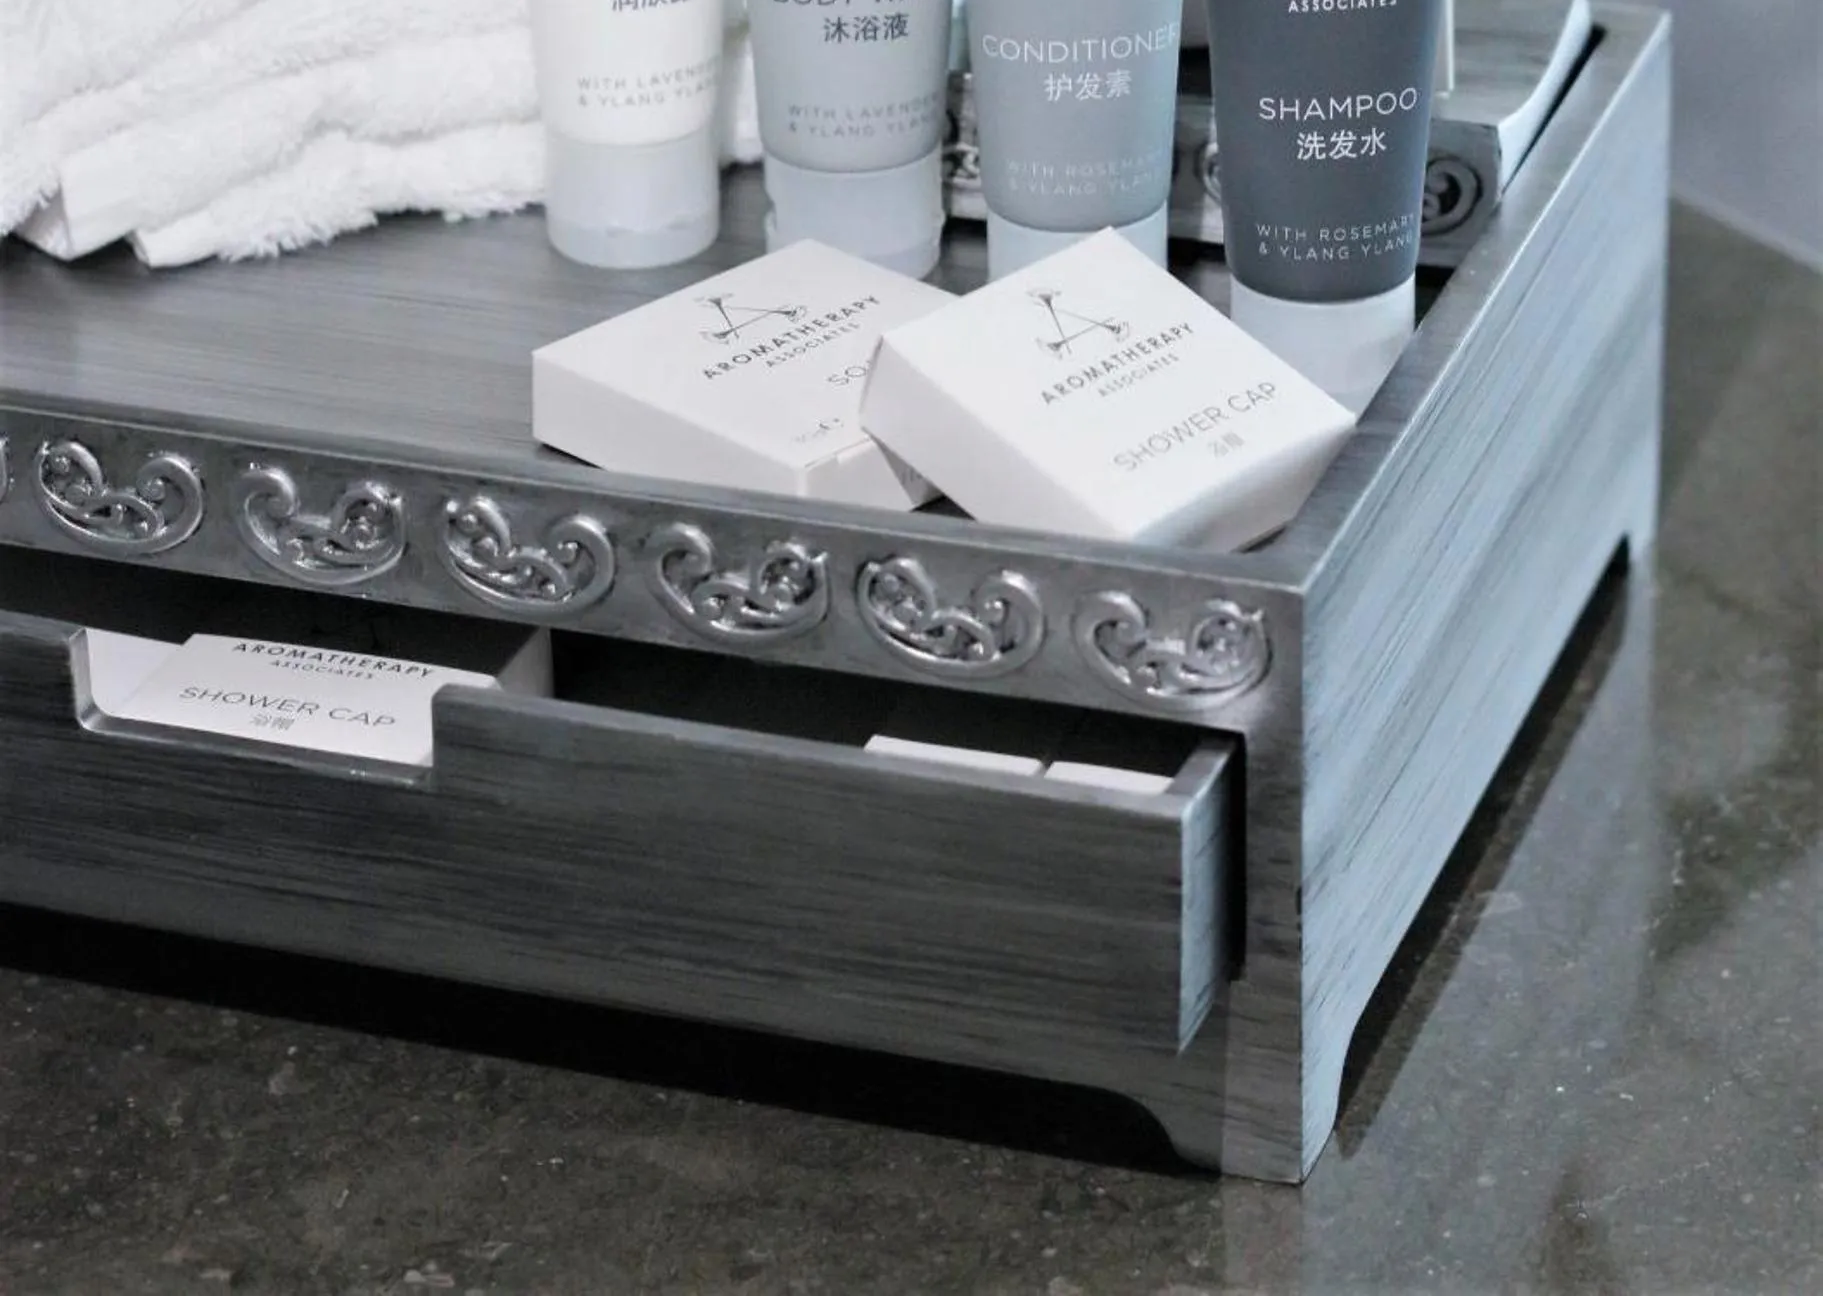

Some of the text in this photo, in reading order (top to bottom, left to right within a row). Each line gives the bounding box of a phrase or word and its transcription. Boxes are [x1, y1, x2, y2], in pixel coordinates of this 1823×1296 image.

[823, 11, 909, 43] 沐浴液
[1043, 68, 1132, 102] 护发素
[1259, 87, 1418, 121] SHAMPOO
[1297, 127, 1387, 160] 洗发水
[1256, 222, 1307, 241] WITH
[1258, 241, 1268, 255] &
[1279, 245, 1350, 260] YLANG
[704, 294, 880, 379] AROMATHERAPY
[767, 322, 860, 368] ASSOCIATES
[1040, 322, 1194, 404] AROMATHERAPY
[1098, 352, 1180, 397] ASSOCIATES
[1112, 382, 1277, 471] SHOWER CAP
[233, 642, 434, 678] AROMATHERAPY
[269, 660, 374, 680] ASSOCIATES
[179, 685, 396, 727] SHOWER CAP
